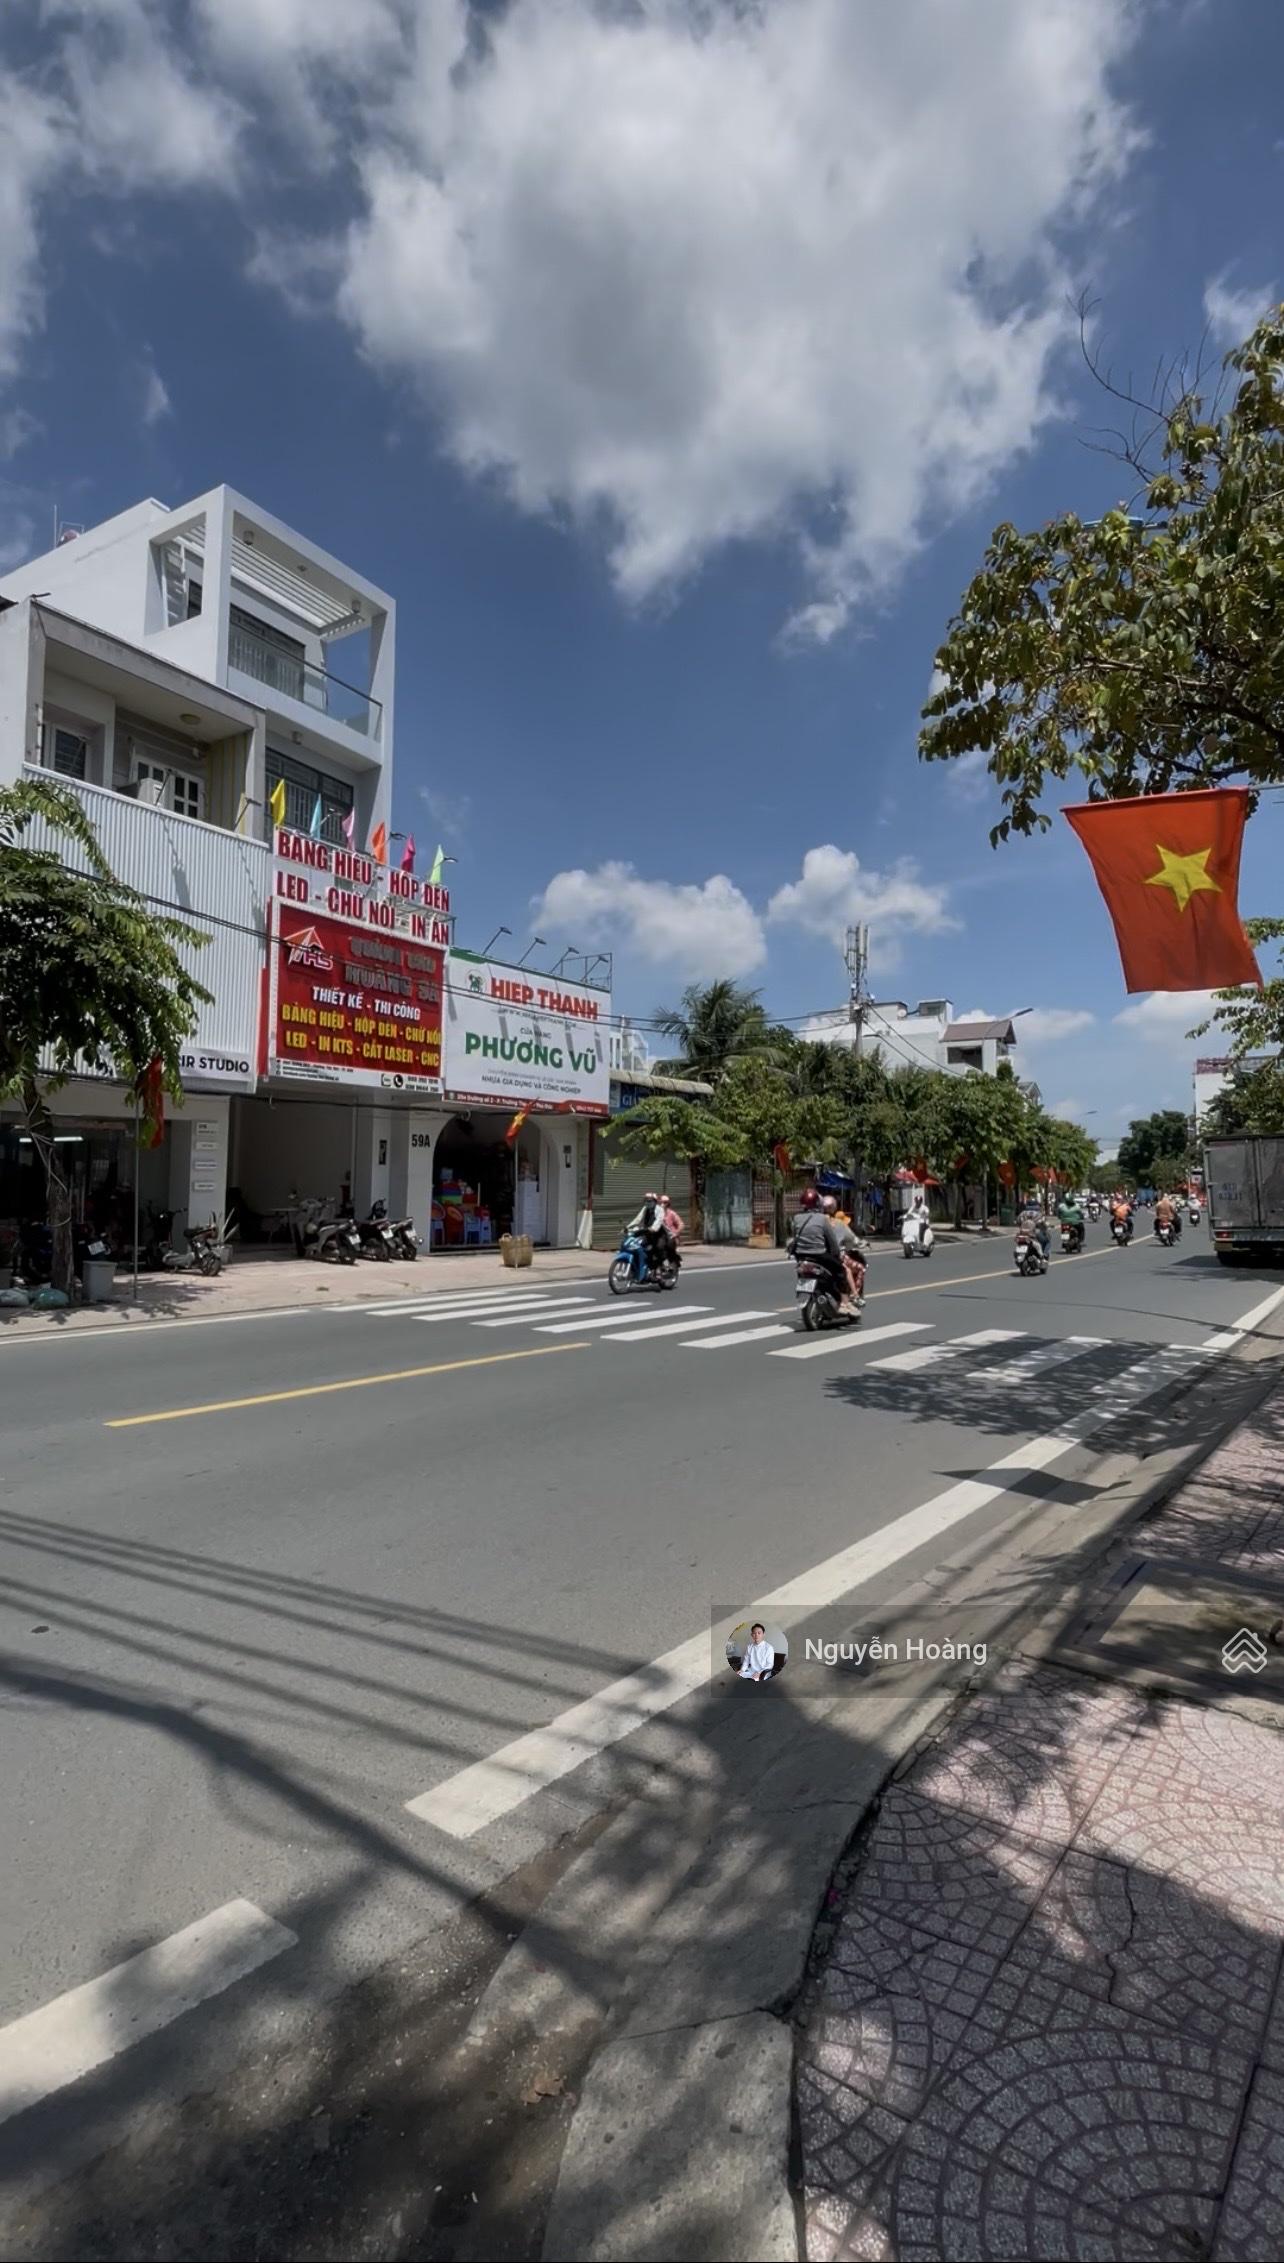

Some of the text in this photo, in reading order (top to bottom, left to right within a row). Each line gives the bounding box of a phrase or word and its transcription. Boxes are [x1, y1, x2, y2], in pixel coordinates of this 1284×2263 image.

[277, 871, 309, 903] LED
[411, 914, 426, 938] IN
[282, 1002, 316, 1025] BẢNG
[319, 1009, 344, 1032] HIỆU
[354, 1017, 375, 1037] HỘP
[312, 986, 346, 1006] THIẾT
[348, 991, 364, 1009] KẾ
[374, 1000, 391, 1014] THI
[393, 1001, 421, 1020] CÔNG
[199, 1056, 249, 1073] STUDIO
[286, 1031, 307, 1049] LED
[318, 1035, 331, 1051] IN
[332, 1038, 353, 1055] KTS
[385, 1046, 413, 1063] LASER
[421, 1053, 440, 1067] CNC
[465, 1032, 597, 1074] PHƯƠNG VŨ
[502, 1078, 514, 1086] GIA
[411, 1134, 430, 1148] 59A
